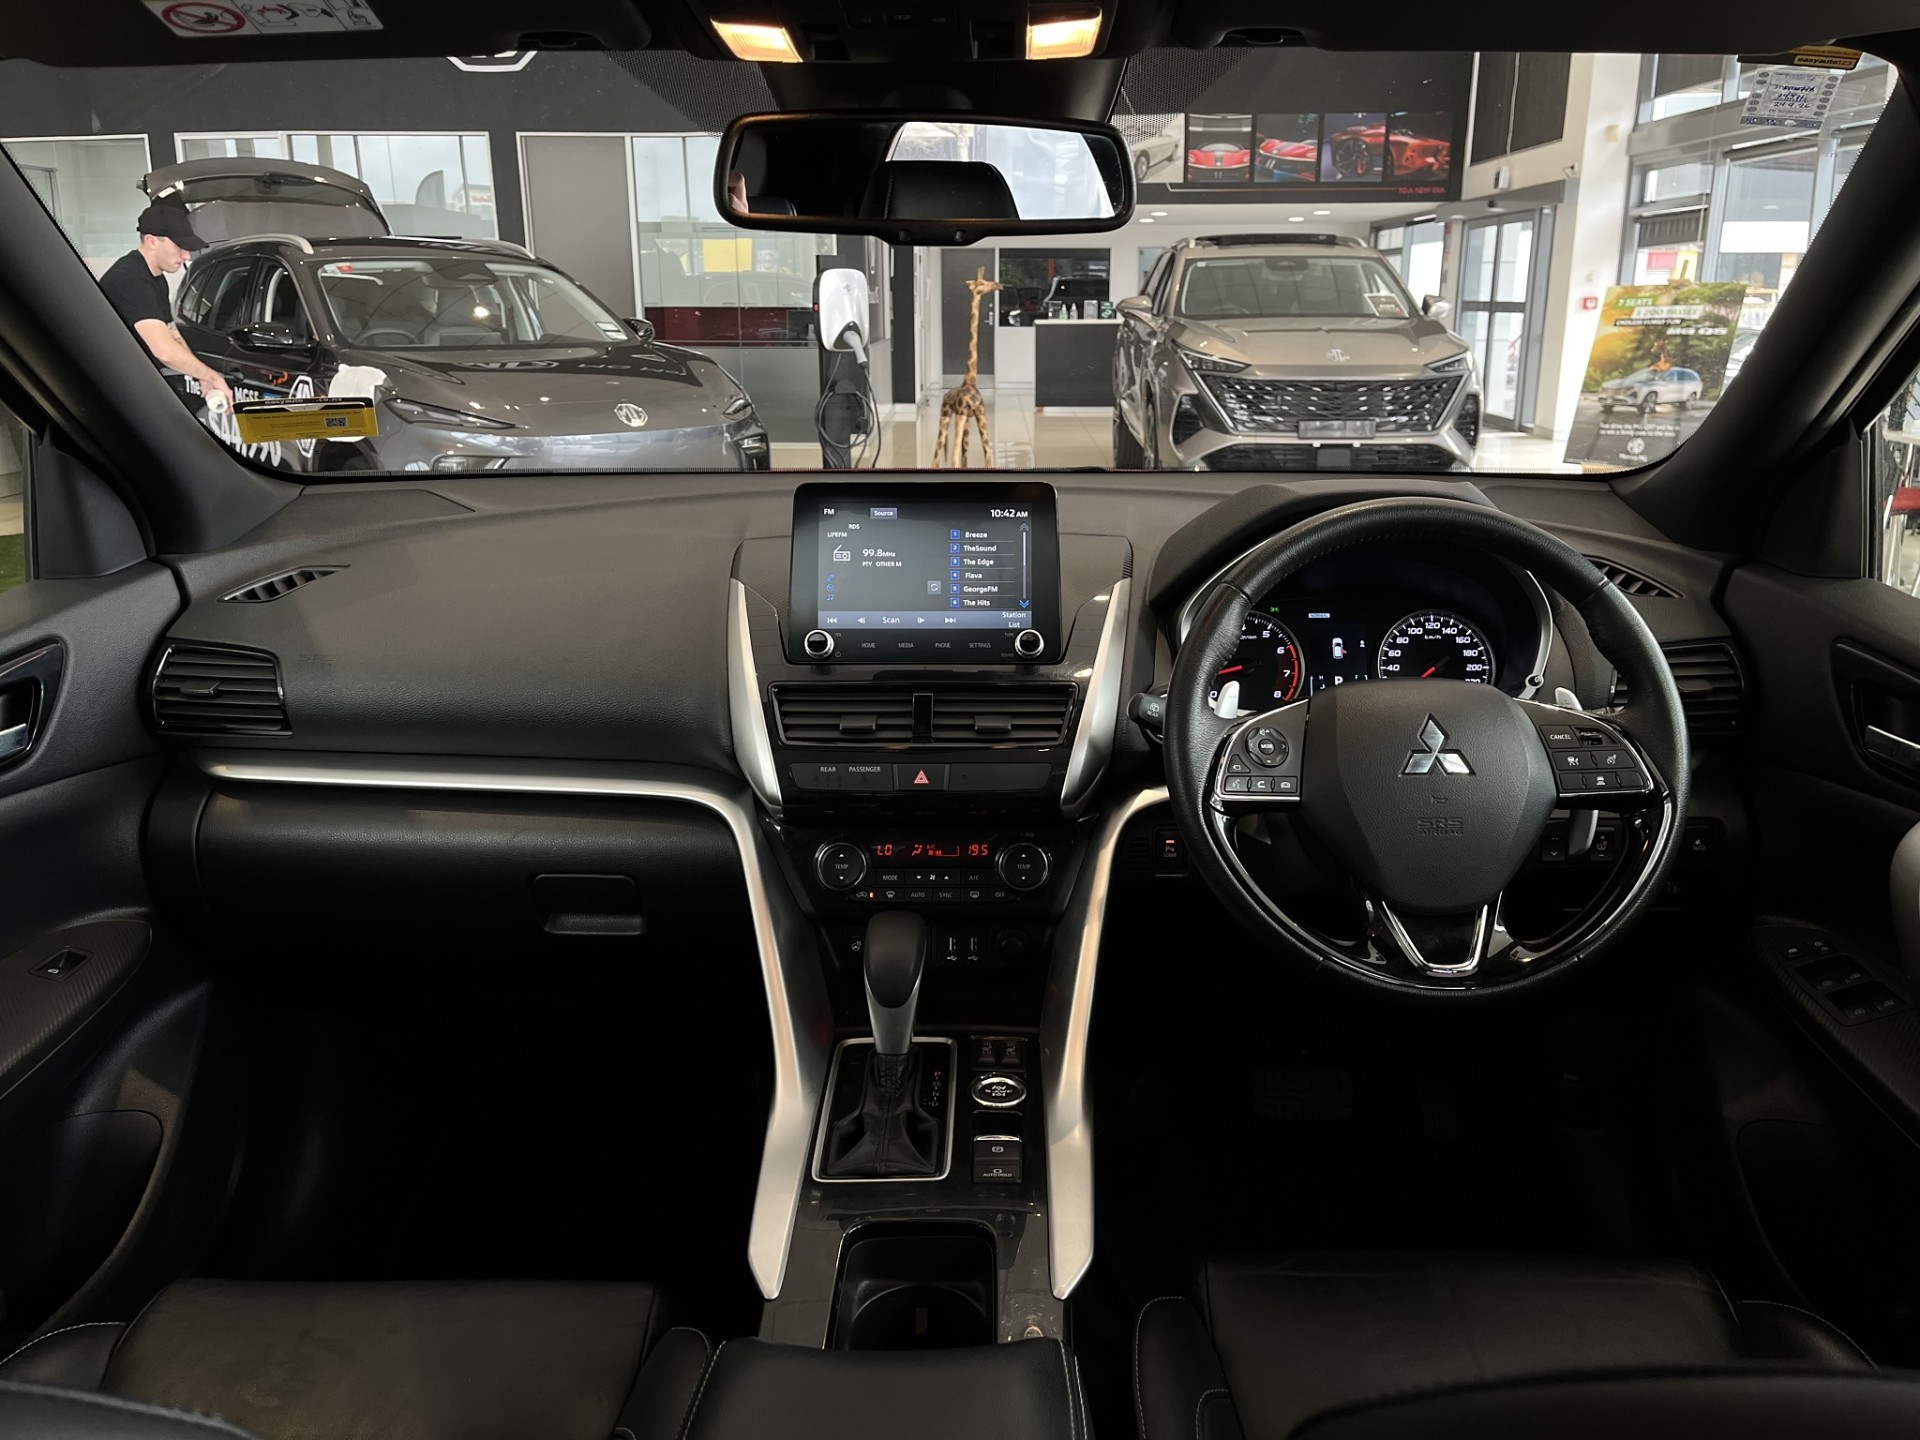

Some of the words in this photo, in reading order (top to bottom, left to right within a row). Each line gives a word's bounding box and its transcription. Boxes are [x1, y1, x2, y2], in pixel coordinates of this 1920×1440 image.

[1797, 57, 1853, 66] easyauto123
[1626, 298, 1653, 306] SEATS
[990, 508, 1015, 518] 10:42
[977, 559, 994, 567] Edge
[963, 586, 998, 594] GeorgeFM
[882, 616, 900, 624] Scan
[1334, 676, 1343, 685] P
[1417, 816, 1464, 829] SRS
[968, 844, 988, 856] 19.5
